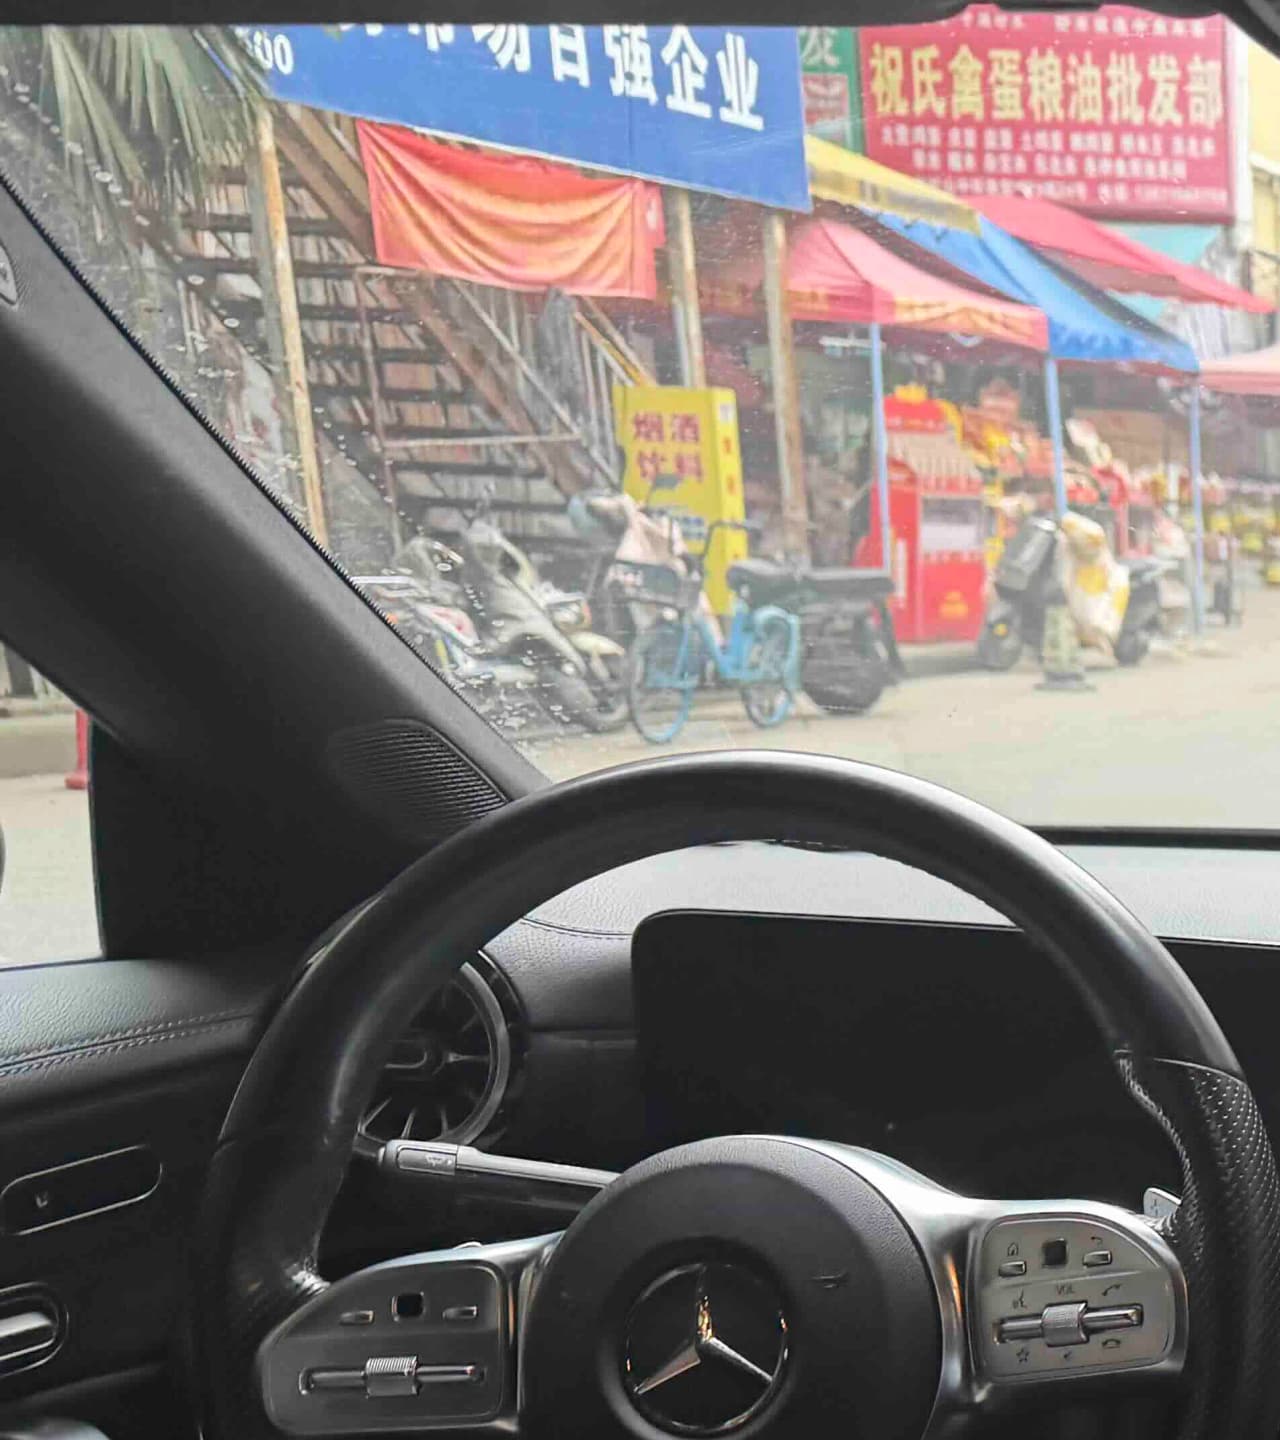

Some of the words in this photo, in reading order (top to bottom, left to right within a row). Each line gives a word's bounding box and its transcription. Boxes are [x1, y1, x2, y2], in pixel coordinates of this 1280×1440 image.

[868, 41, 1224, 130] 祝氏禽蛋粮油批发部
